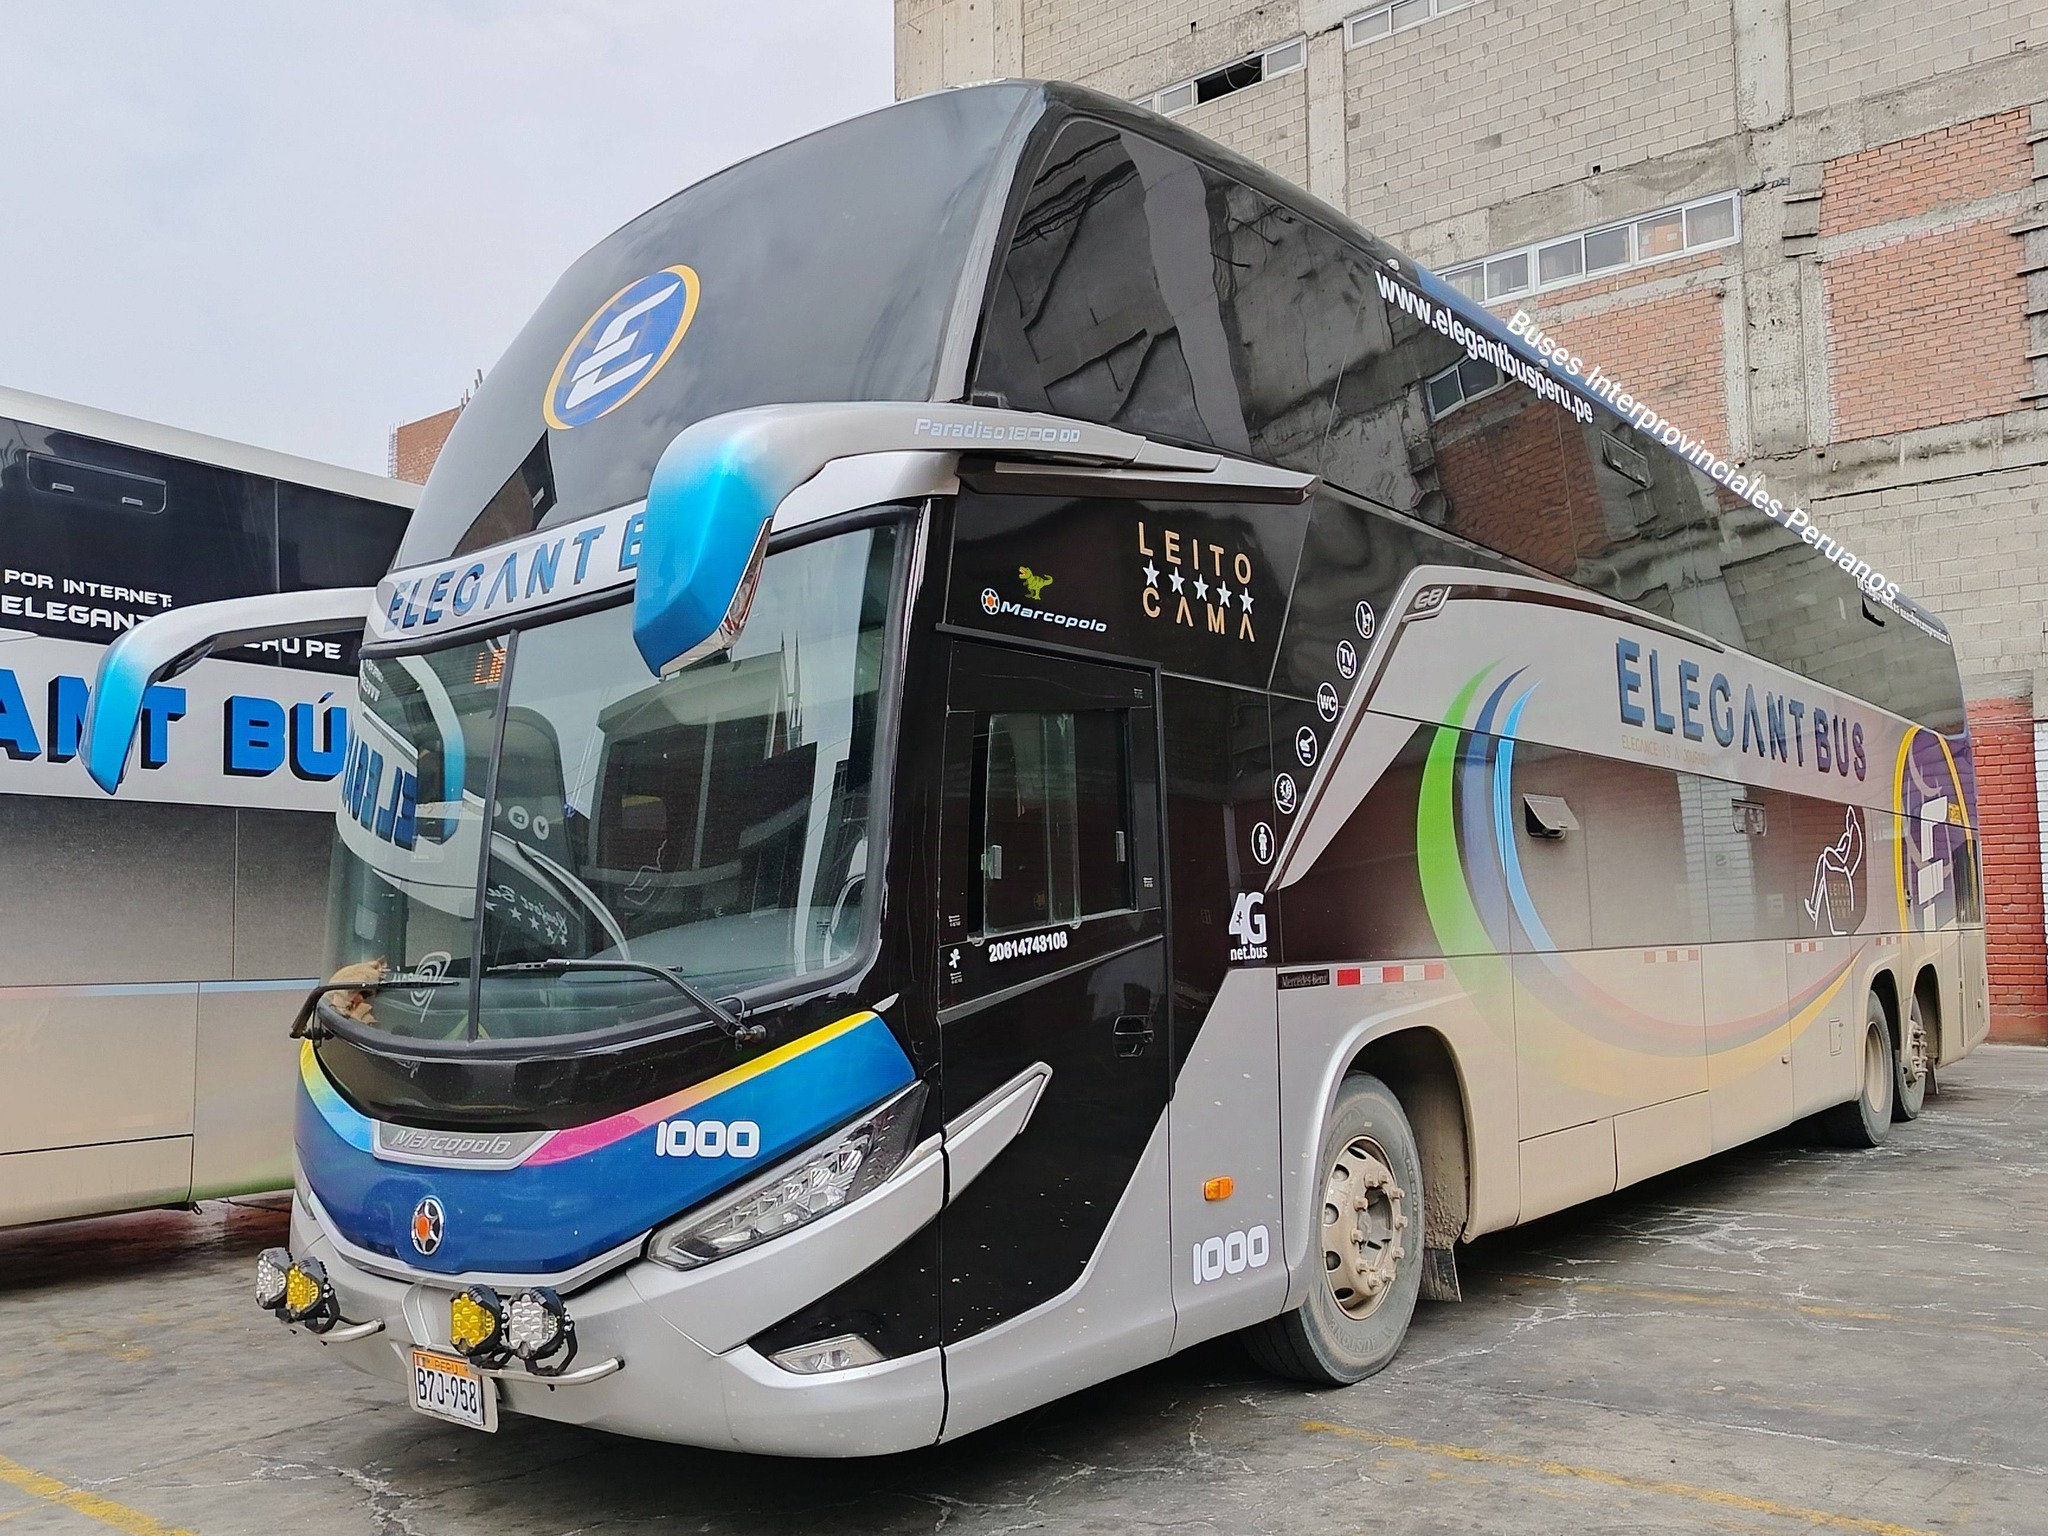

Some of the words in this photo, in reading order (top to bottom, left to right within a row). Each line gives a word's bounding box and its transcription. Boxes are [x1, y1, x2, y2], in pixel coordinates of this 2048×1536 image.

[1374, 270, 1593, 424] www.elegantbusperu.pe
[914, 418, 1004, 439] Paradiso
[1008, 426, 1057, 442] 1800
[1059, 429, 1081, 443] DD
[1138, 521, 1252, 585] LEITO
[4, 569, 54, 590] POR
[63, 578, 173, 608] INTERNET:
[384, 525, 605, 634] ELEGANT
[1000, 600, 1109, 633] Marcopolo
[1142, 586, 1256, 642] CAMA
[1340, 647, 1355, 667] TV
[1320, 693, 1336, 712] WC
[1616, 637, 1805, 767] ELEGANT
[1813, 706, 1867, 782] BUS
[1229, 892, 1267, 945] 4G
[1230, 944, 1268, 961] net.bus
[389, 1129, 512, 1155] Marcopolo
[656, 1120, 760, 1158] 1000
[1193, 1225, 1270, 1285] 1000
[434, 1360, 458, 1375] PERU
[417, 1367, 478, 1414] B7J-958
